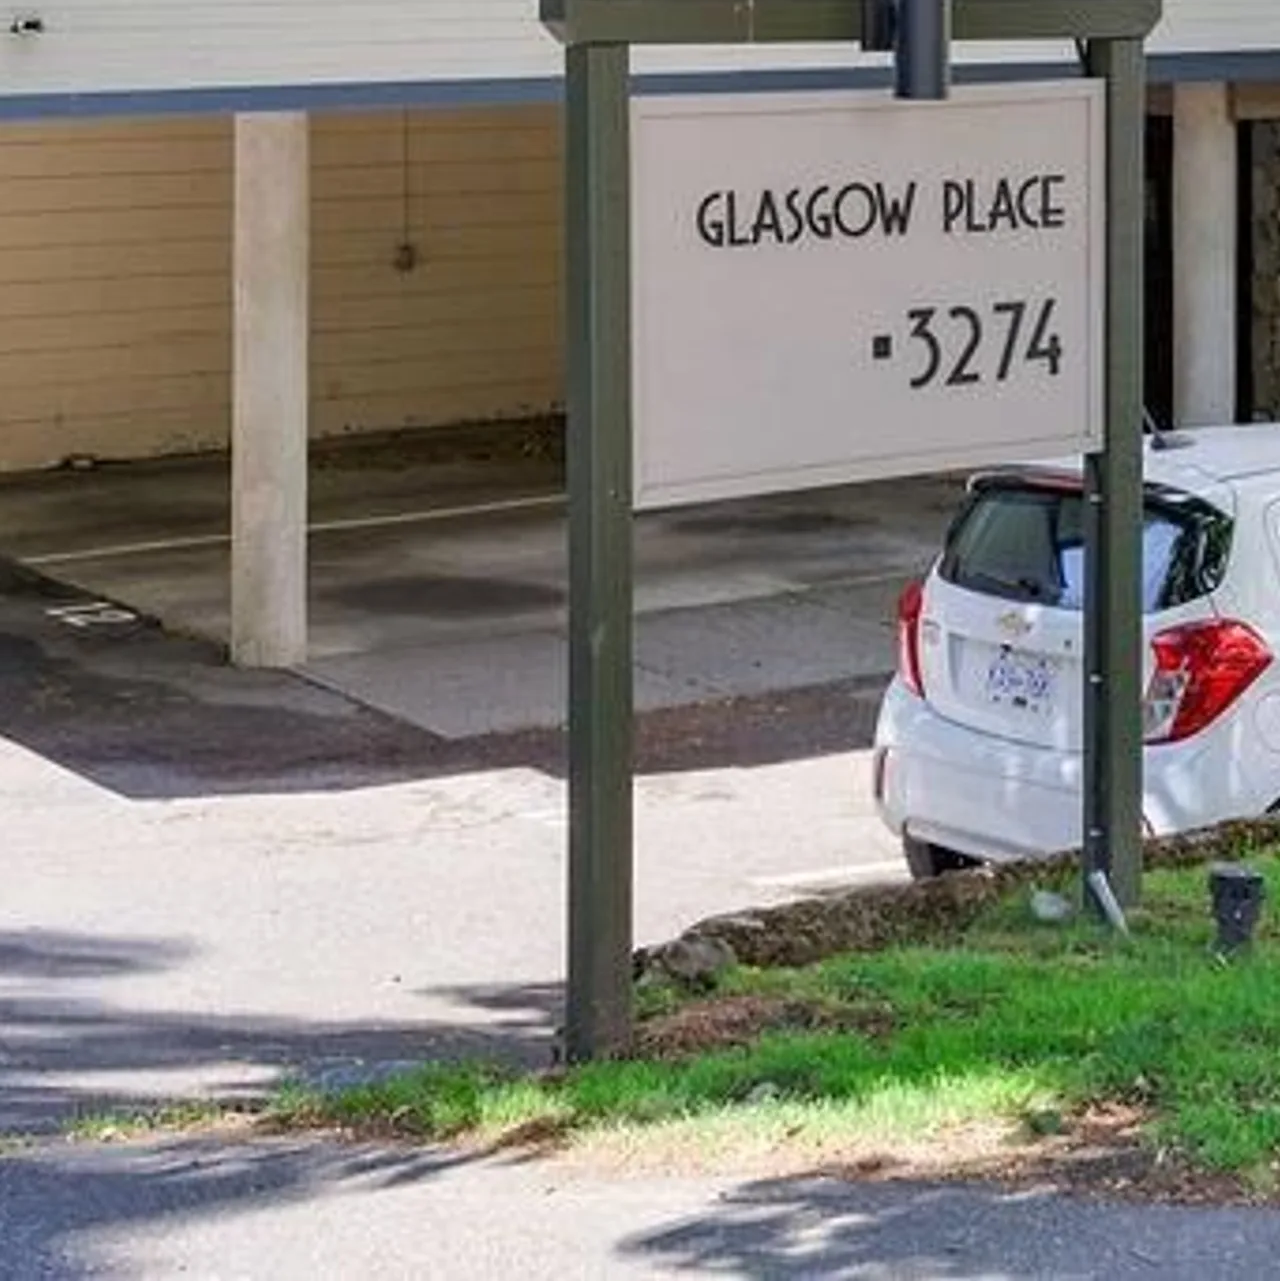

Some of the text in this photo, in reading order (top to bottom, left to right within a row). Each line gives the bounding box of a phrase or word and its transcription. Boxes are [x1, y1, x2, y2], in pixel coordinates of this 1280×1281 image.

[697, 175, 1065, 247] GLASGOW PLACE
[907, 298, 1062, 389] 3274
